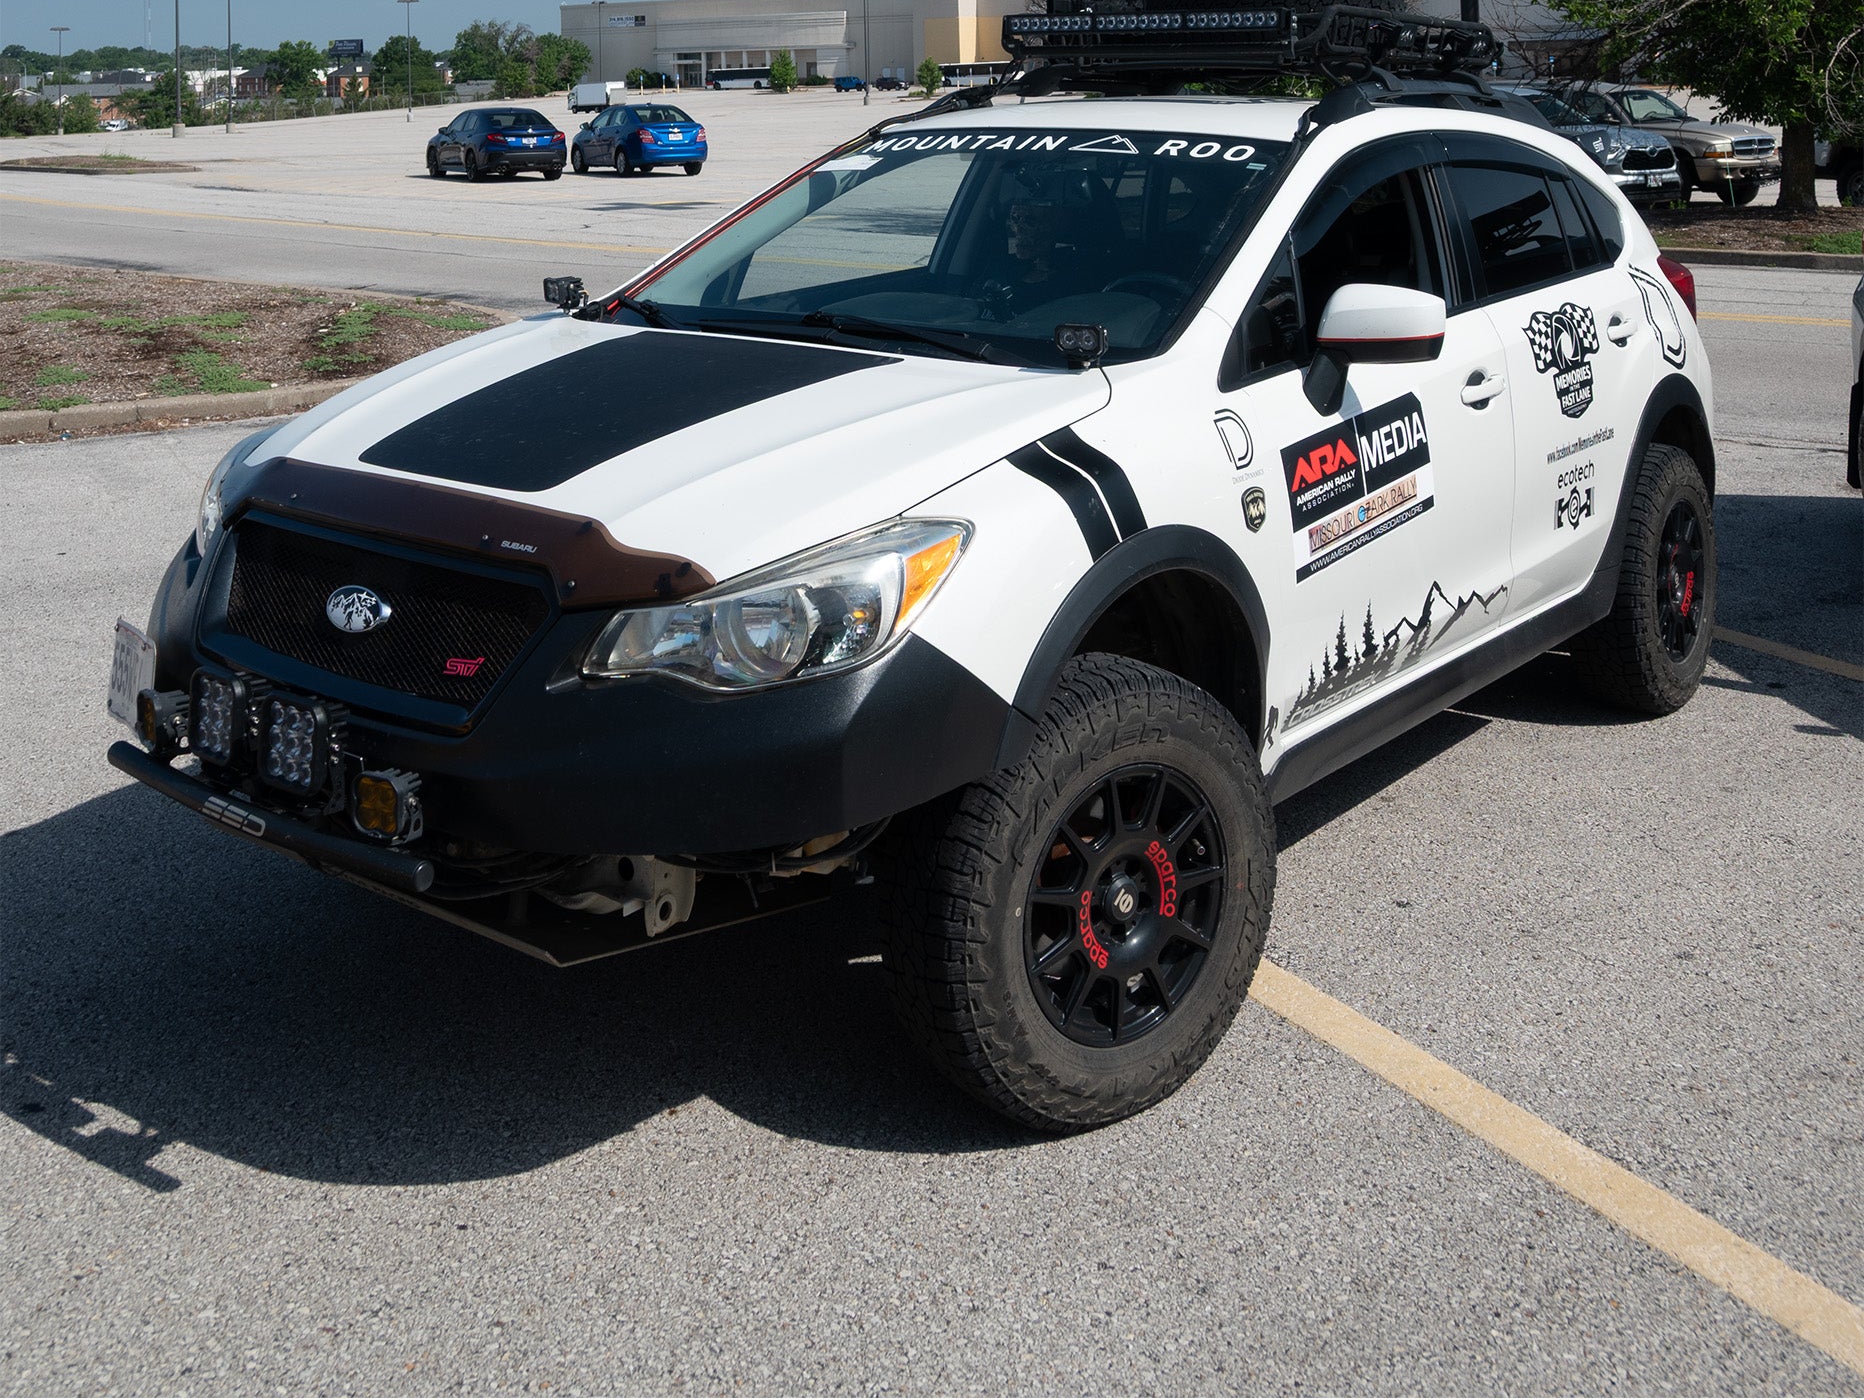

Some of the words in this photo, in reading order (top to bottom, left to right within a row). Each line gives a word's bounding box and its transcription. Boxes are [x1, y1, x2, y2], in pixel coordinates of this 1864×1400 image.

[865, 134, 1069, 154] MOUNTAIN
[1153, 139, 1256, 162] ROO
[1555, 364, 1592, 392] MEMORIES
[1561, 391, 1576, 408] FAST
[1575, 386, 1592, 403] LANE
[1360, 411, 1427, 472] MEDIA
[1290, 438, 1358, 493] ARA
[1557, 459, 1595, 489] ecotech
[1296, 480, 1335, 507] AMERICAN
[1334, 469, 1356, 491] RALLY
[1302, 482, 1352, 512] ASSOCIATION
[1308, 510, 1356, 550] MISSOURI
[1390, 476, 1417, 505] RALLY
[500, 540, 538, 554] SUBARU
[1288, 670, 1382, 728] CROSSTREK
[1144, 840, 1177, 917] sparco
[1080, 890, 1109, 969] sparco
